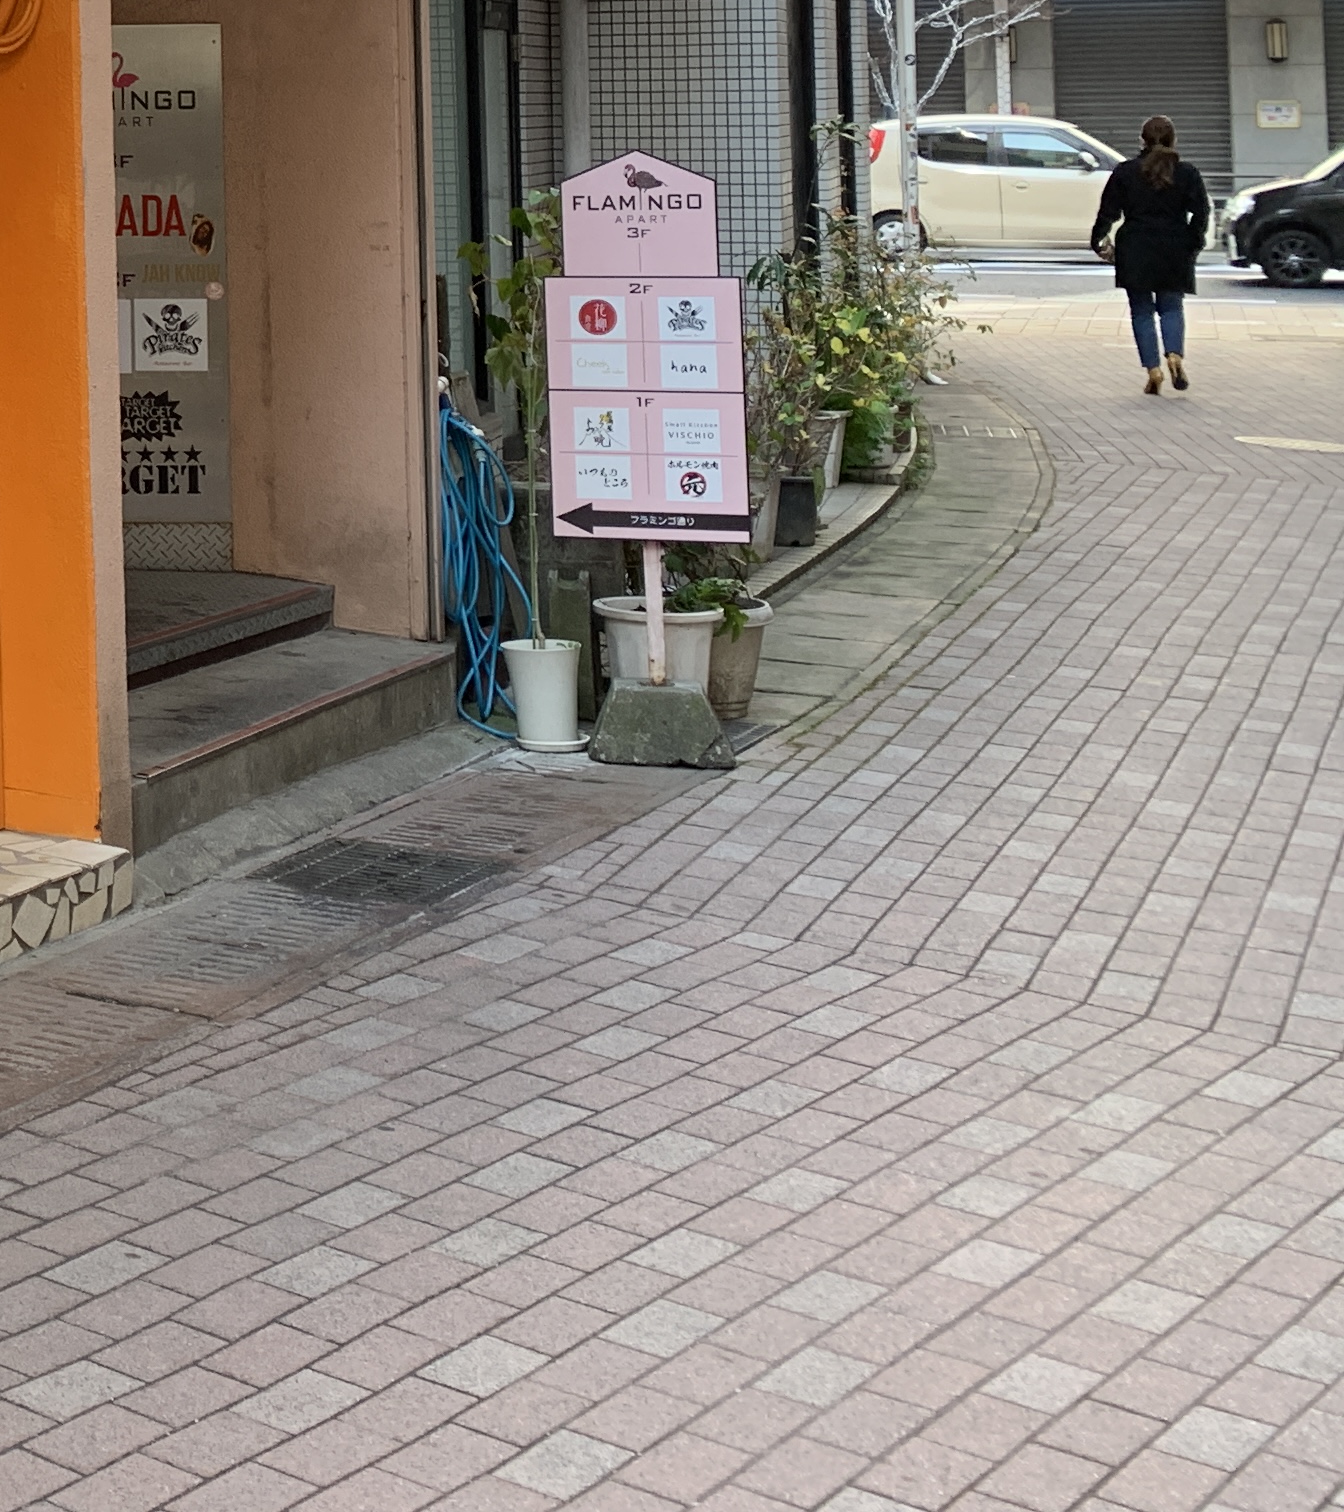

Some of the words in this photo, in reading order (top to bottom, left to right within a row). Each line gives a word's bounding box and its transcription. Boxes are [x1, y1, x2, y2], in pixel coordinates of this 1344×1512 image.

[112, 87, 196, 110] INGO
[117, 116, 154, 127] ART
[572, 193, 702, 211] FLAMINGO
[115, 194, 187, 237] ADA
[614, 215, 668, 224] APART
[627, 227, 651, 238] 3F
[629, 283, 653, 294] 2F
[142, 330, 203, 357] Pirates
[671, 360, 708, 374] hana
[636, 397, 655, 408] 1F
[125, 405, 172, 418] TARGET
[121, 418, 178, 434] ARGET
[668, 431, 715, 440] VISCHIO
[630, 514, 695, 527] フラミンゴ通り
